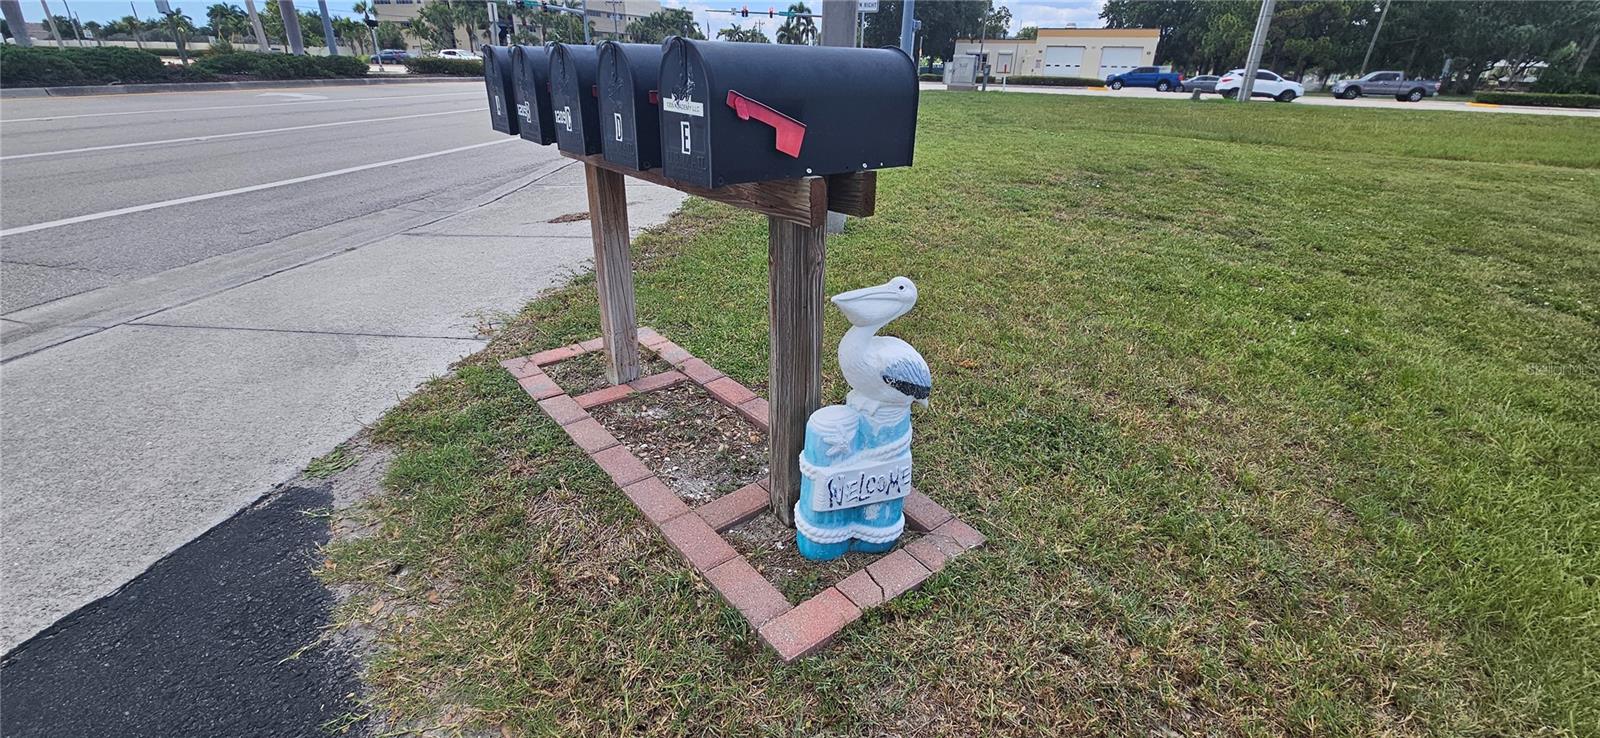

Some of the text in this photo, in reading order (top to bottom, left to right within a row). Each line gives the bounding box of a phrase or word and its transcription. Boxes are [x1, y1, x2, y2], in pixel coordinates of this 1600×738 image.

[615, 115, 622, 140] D
[682, 123, 690, 153] E
[827, 465, 911, 508] WELCOME
